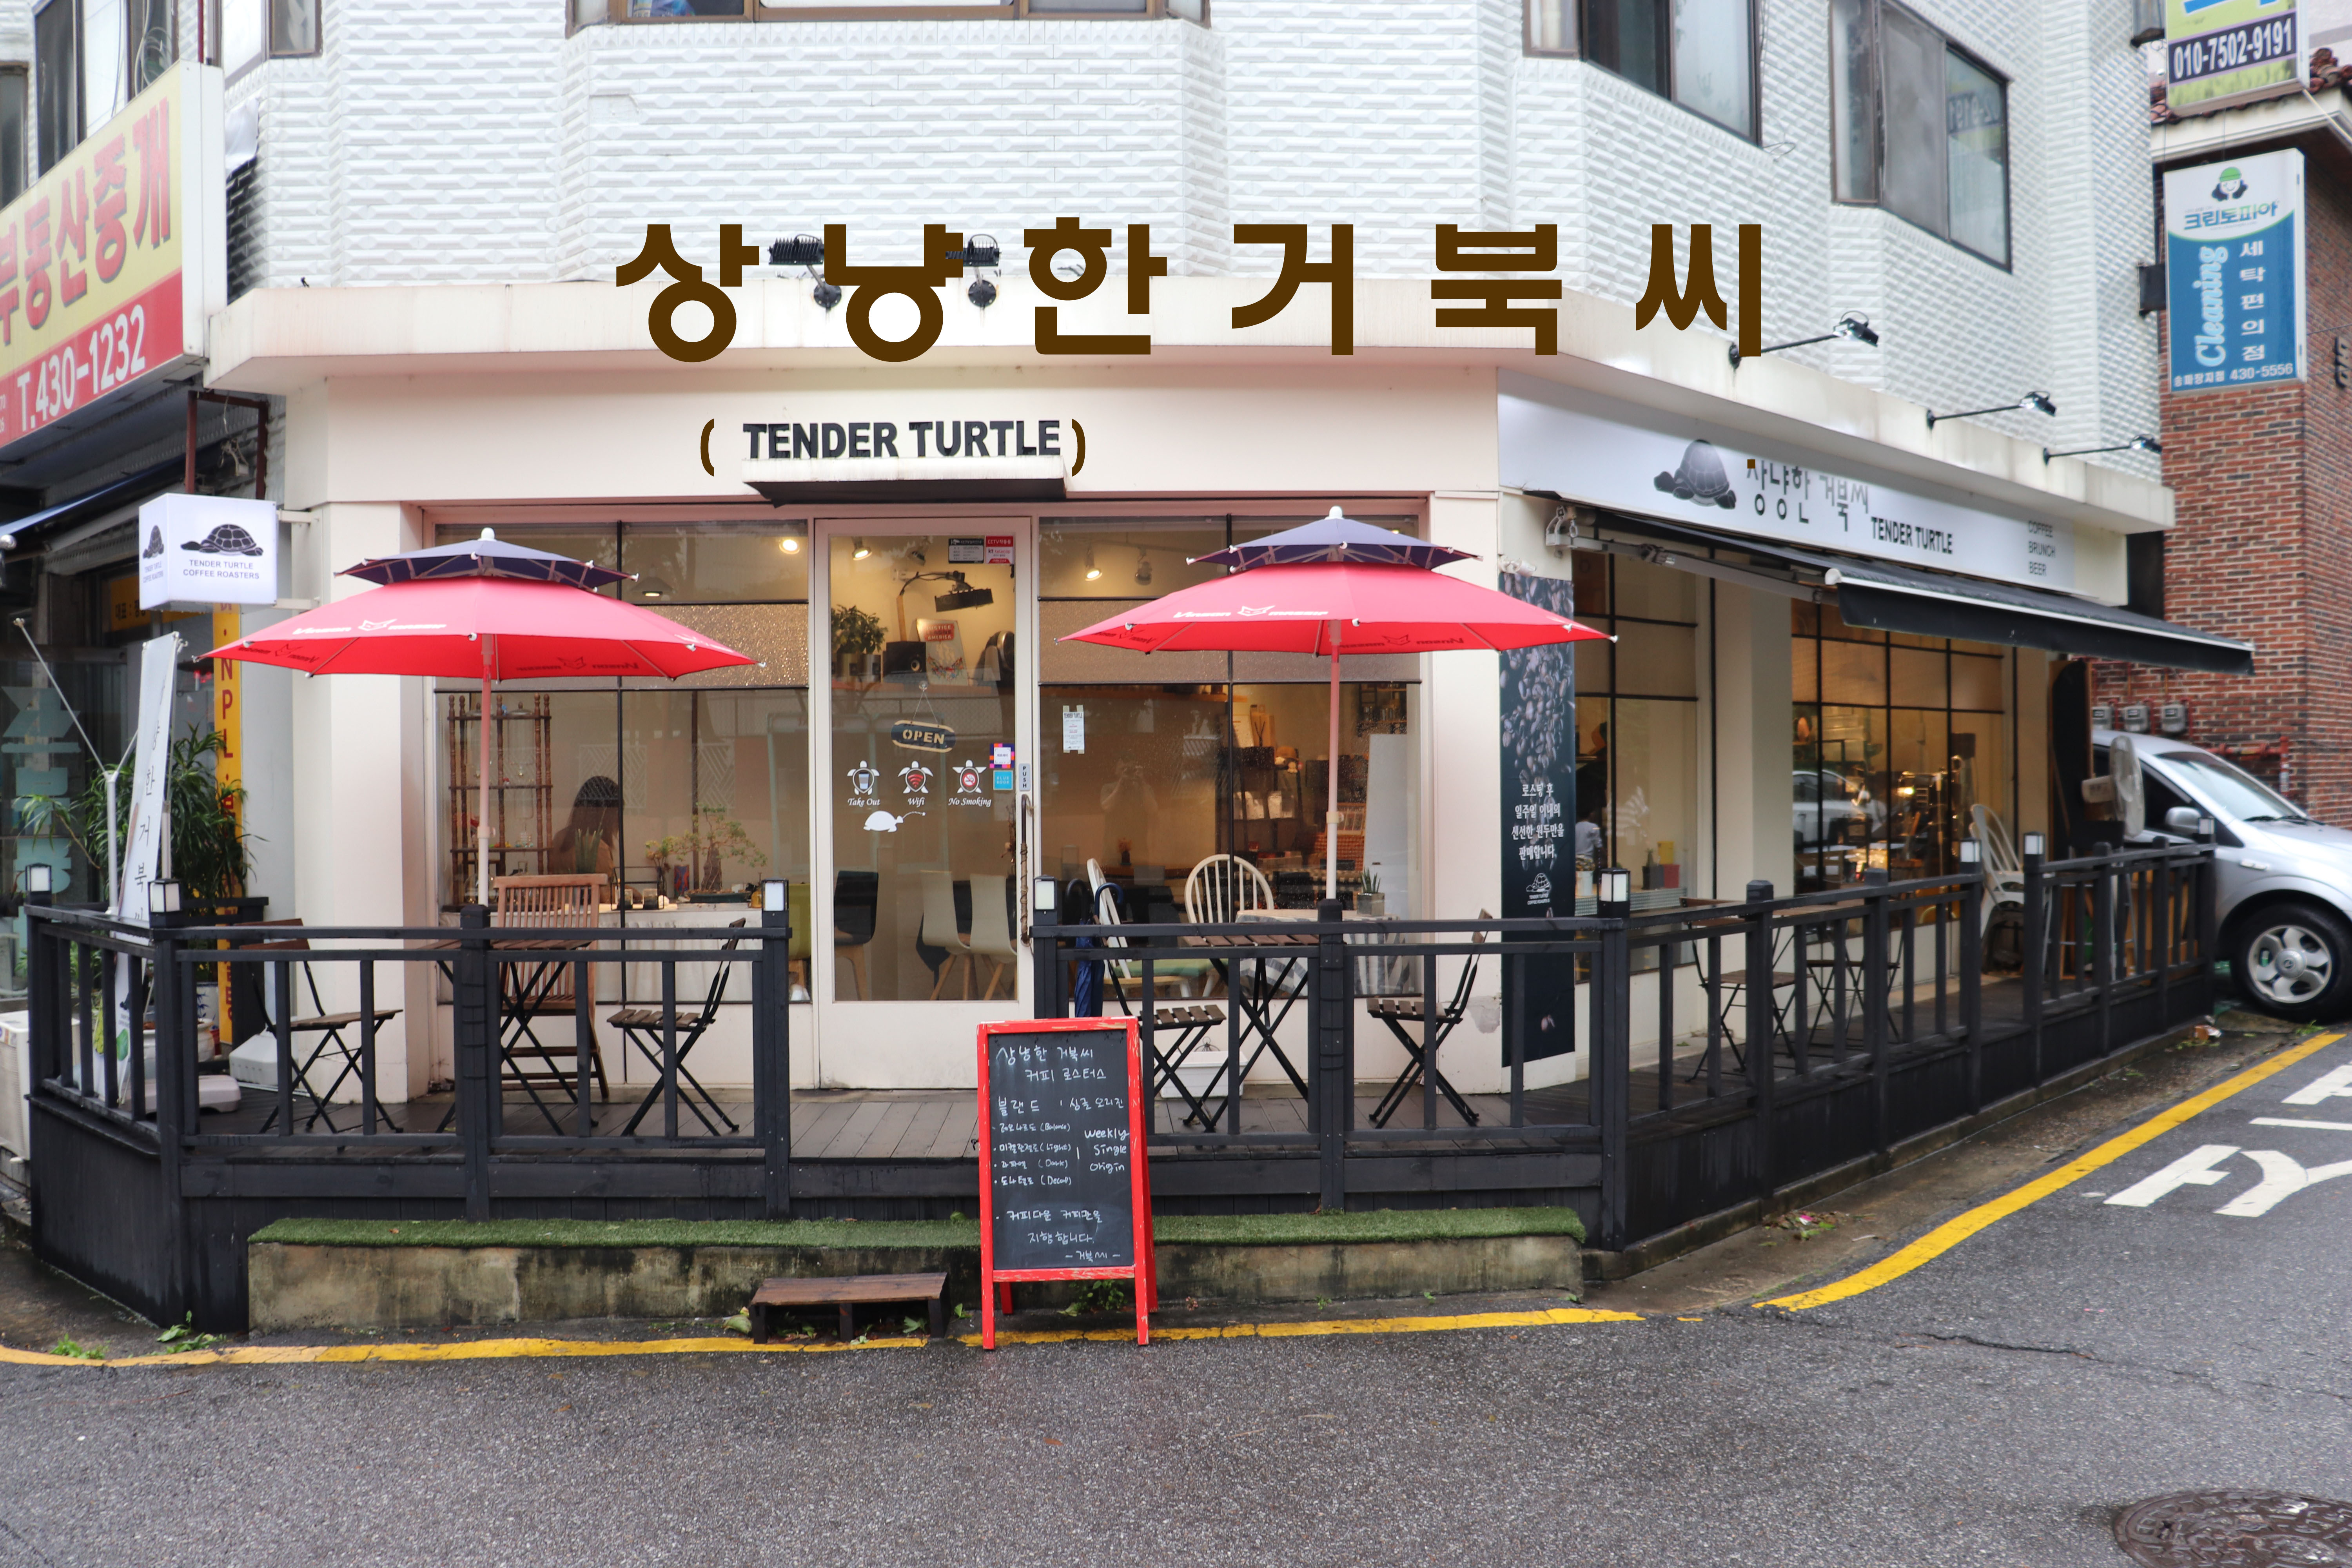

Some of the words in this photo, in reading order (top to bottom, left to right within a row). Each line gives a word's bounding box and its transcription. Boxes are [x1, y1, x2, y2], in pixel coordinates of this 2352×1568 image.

[2174, 18, 2292, 79] 010-7502-9191
[2184, 201, 2278, 230] 크린토피아
[2192, 246, 2229, 367] Cleaning
[16, 303, 146, 432] T.430-1232
[2230, 363, 2293, 380] 430-5556
[743, 422, 898, 459] TENDER
[909, 421, 1061, 457] TURTLE
[1871, 517, 1913, 546] TENDER
[1915, 526, 1953, 554] TURTLE
[2029, 520, 2053, 538] COFFEE
[2029, 541, 2056, 558] BRUNCH
[189, 559, 221, 568] TENDER
[2029, 561, 2047, 576] BEER
[217, 571, 260, 579] ROASTERS
[902, 729, 945, 744] OPEN
[1522, 783, 1543, 797] 로스팅
[1546, 783, 1553, 797] 후
[848, 797, 865, 807] Take
[866, 798, 880, 806] Out
[907, 797, 925, 807] Wifi
[948, 798, 960, 806] No
[960, 797, 992, 807] Smoking
[1515, 804, 1537, 819] 일주일
[1539, 803, 1560, 817] 이내의
[1512, 825, 1534, 840] 신선한
[1536, 823, 1564, 838] 원두만을
[996, 1045, 1047, 1065] 상냥한
[1057, 1046, 1093, 1061] 거북씨
[1025, 1069, 1054, 1082] 커피
[1062, 1068, 1106, 1081] 로스터스
[1094, 1144, 1127, 1156] Single
[1001, 1160, 1027, 1169] 라파엘
[1007, 1210, 1051, 1221] 커피다운
[1060, 1210, 1102, 1223] 커피만을
